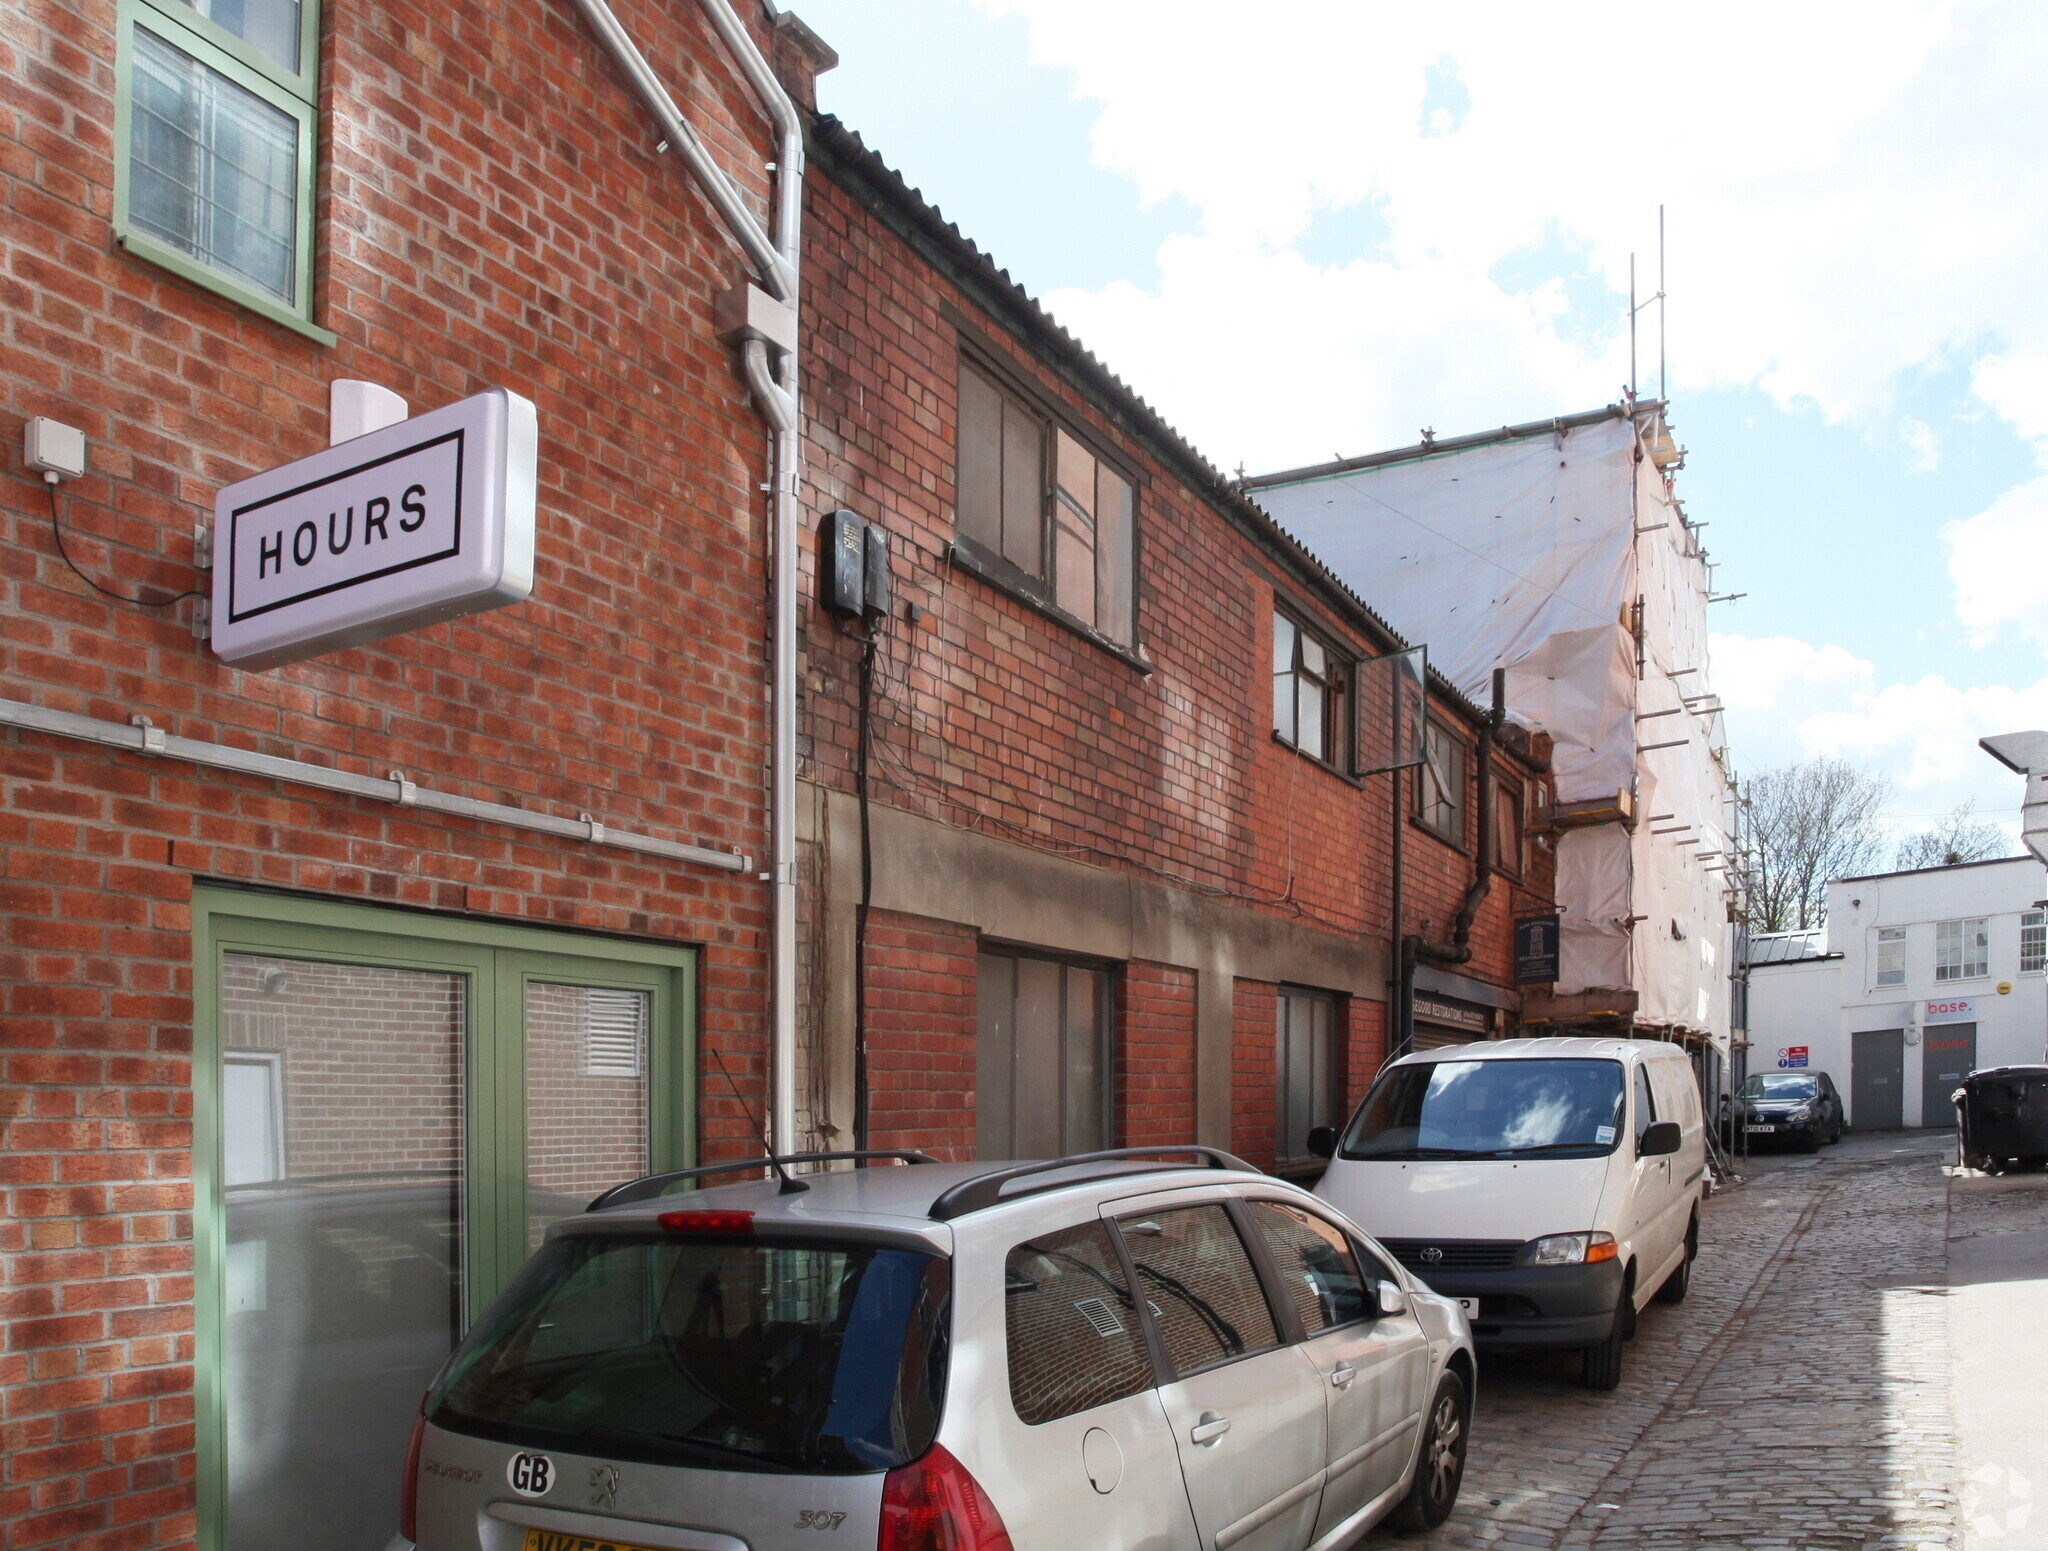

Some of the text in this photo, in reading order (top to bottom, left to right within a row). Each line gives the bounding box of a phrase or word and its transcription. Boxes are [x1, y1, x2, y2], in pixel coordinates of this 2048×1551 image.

[259, 484, 427, 580] HOURS
[1928, 1002, 1972, 1014] base.
[424, 1459, 483, 1484] PEUGEOT
[512, 1453, 549, 1493] GB
[793, 1509, 848, 1531] 307
